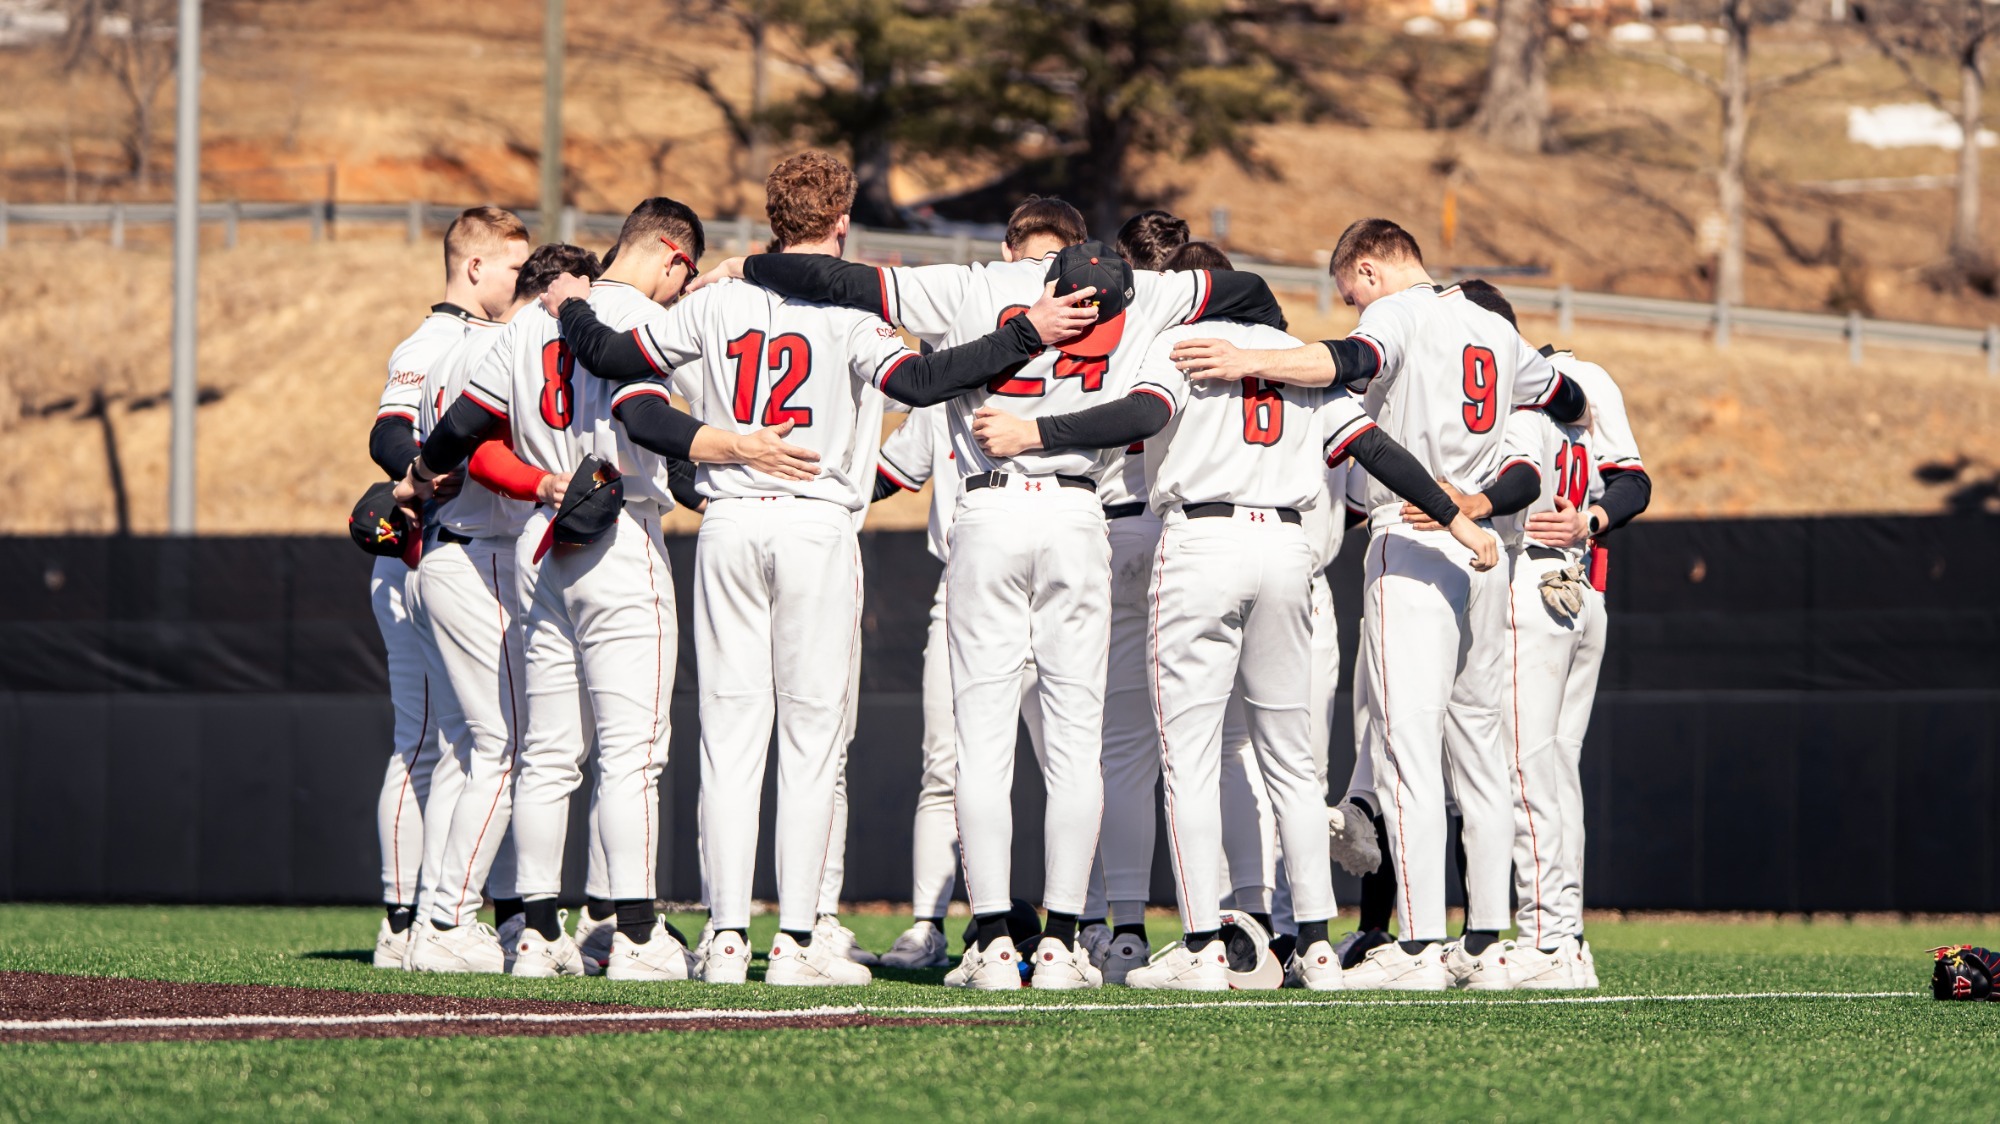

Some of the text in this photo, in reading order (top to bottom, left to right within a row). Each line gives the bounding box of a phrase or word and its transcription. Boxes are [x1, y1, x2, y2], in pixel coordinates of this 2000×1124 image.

[539, 338, 576, 431] 8
[726, 328, 812, 427] 12
[1241, 375, 1284, 447] 6
[1462, 343, 1497, 434] 9
[1555, 439, 1588, 513] 10
